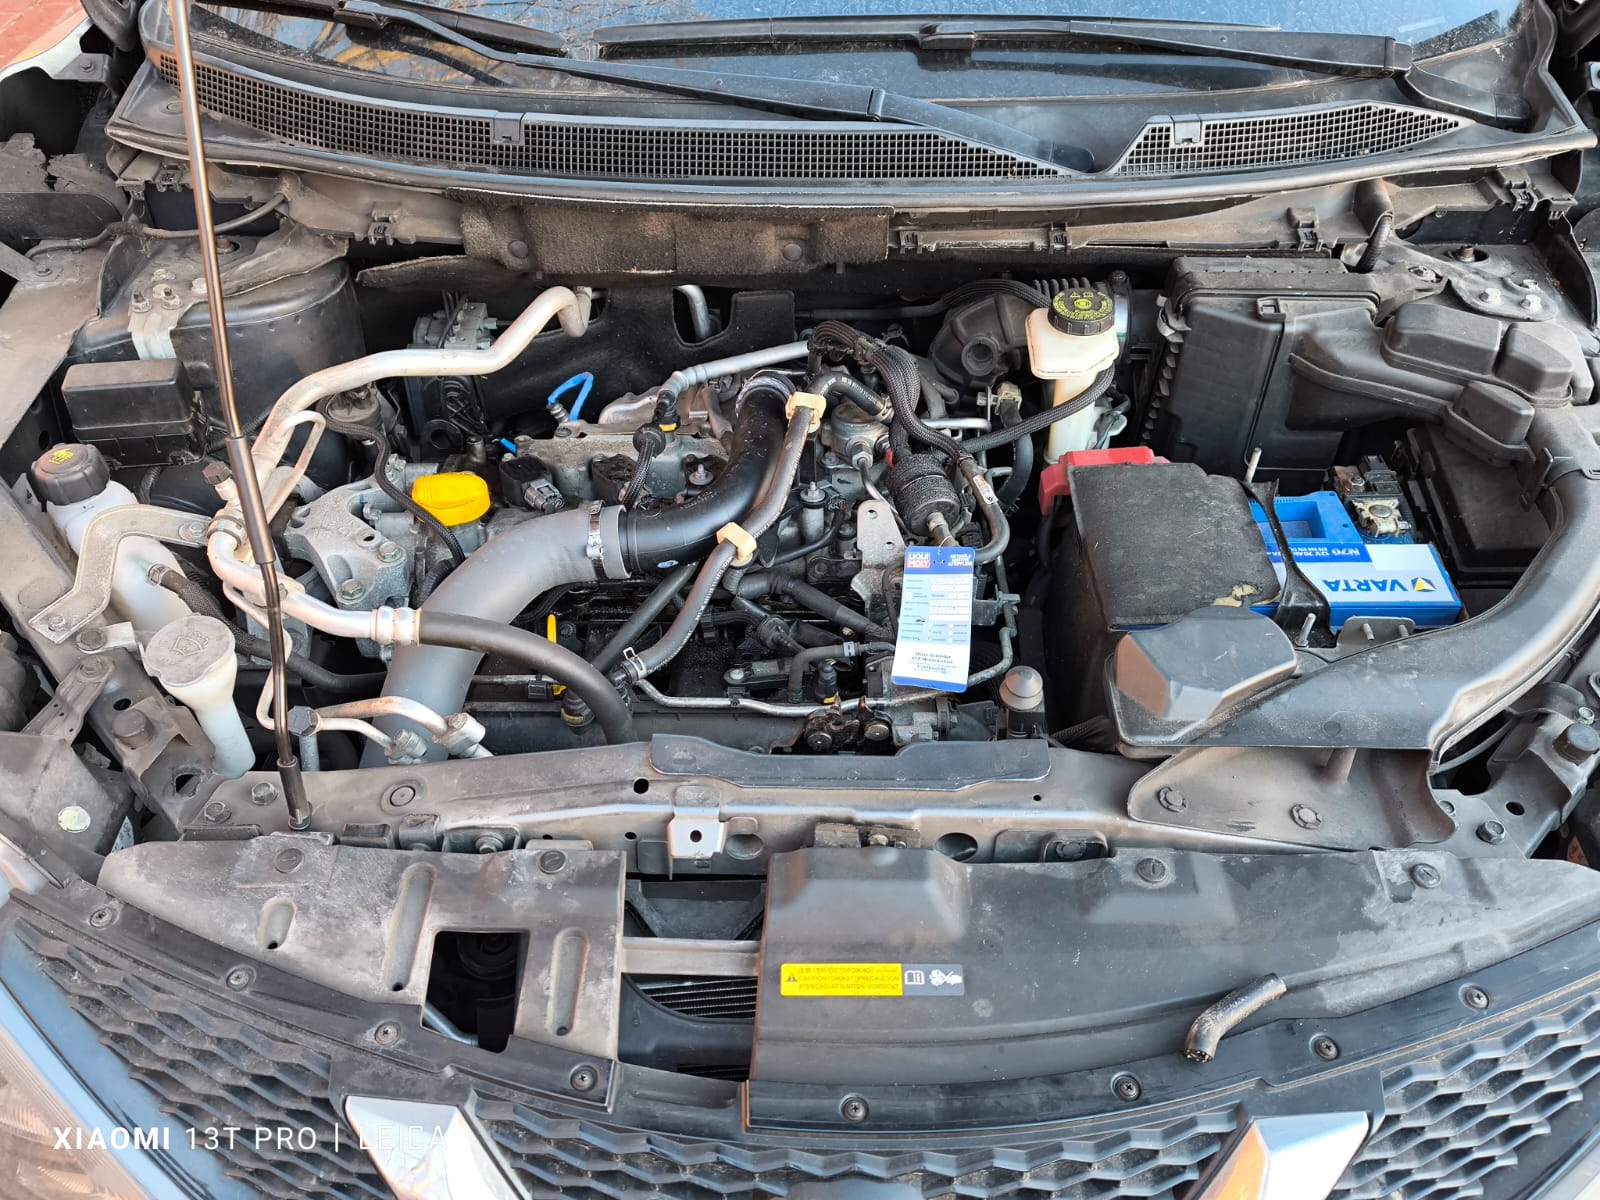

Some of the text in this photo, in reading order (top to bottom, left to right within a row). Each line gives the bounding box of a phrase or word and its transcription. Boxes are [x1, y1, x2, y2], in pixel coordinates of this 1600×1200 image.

[908, 551, 930, 560] LIQUI
[908, 560, 930, 568] MOLY
[1323, 579, 1407, 592] VARTA
